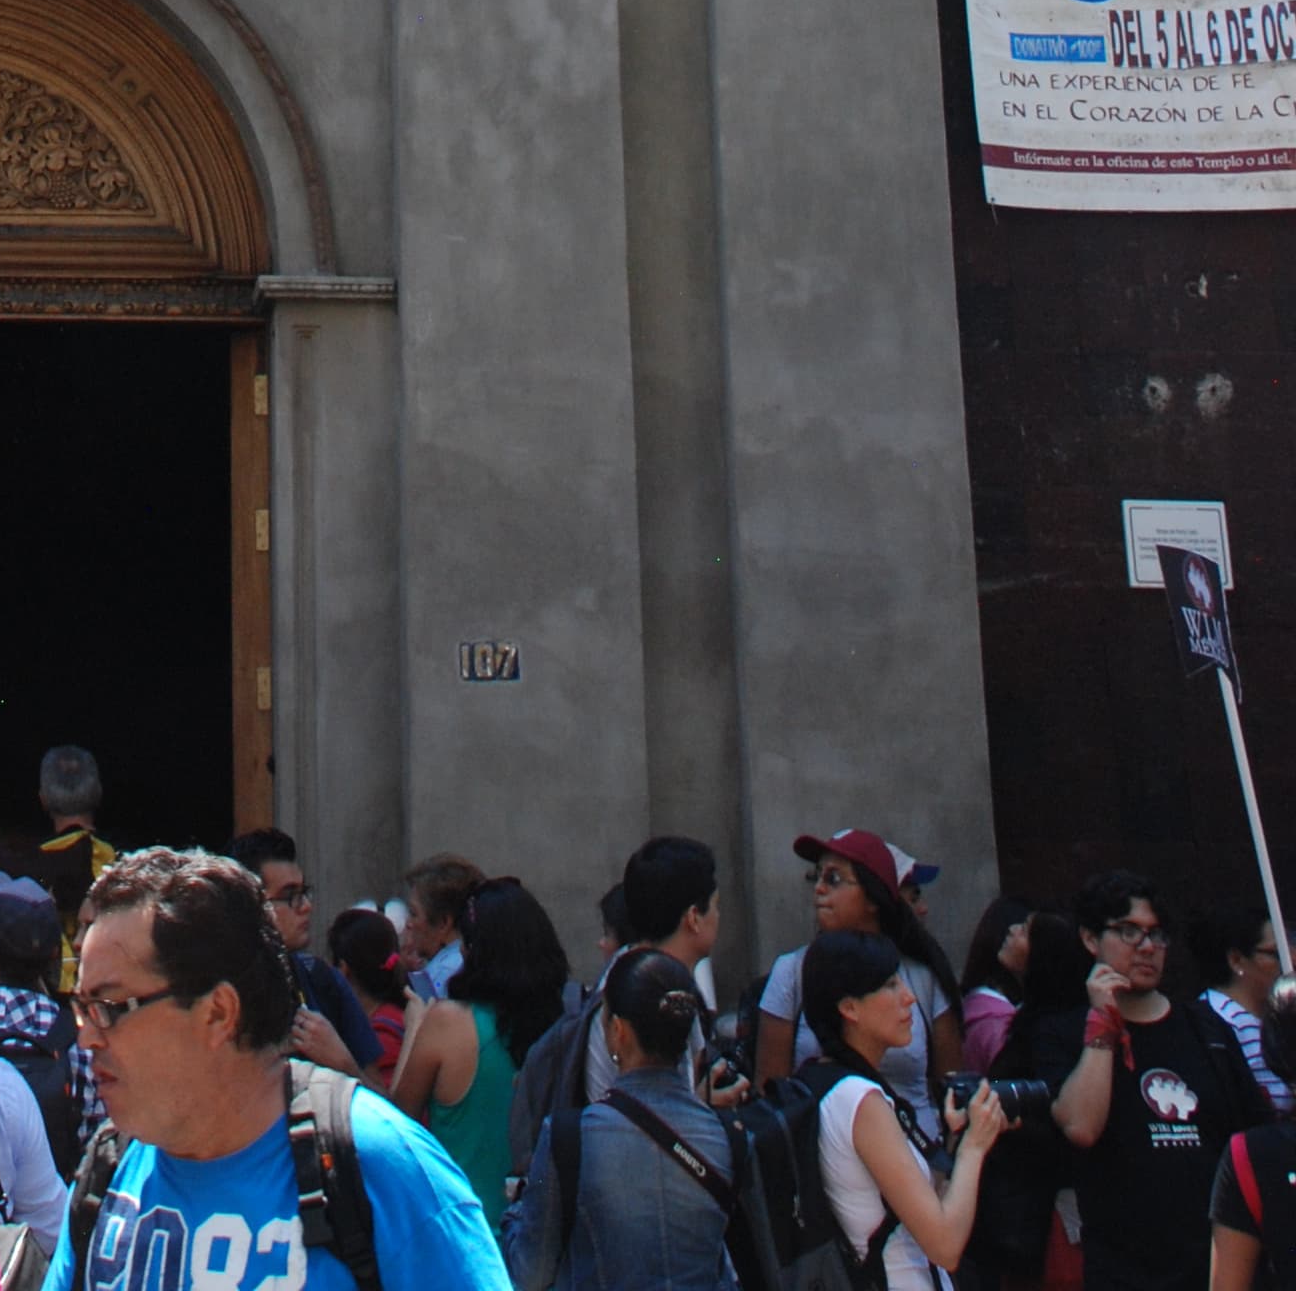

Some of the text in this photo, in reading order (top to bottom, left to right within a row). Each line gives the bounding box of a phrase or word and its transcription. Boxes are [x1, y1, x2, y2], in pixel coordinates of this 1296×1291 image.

[1109, 9, 1152, 68] DEL
[1155, 9, 1169, 68] 5
[1175, 9, 1204, 69] AL
[1207, 10, 1222, 66] 6
[1225, 7, 1258, 64] DE
[1000, 71, 1040, 88] UNA
[1050, 74, 1183, 92] EXPERIENCIA
[1193, 75, 1221, 92] DE
[1003, 95, 1296, 123] EN EL CORAZÓN DE LA C
[1014, 152, 1071, 166] Infórmate
[1074, 157, 1089, 167] en
[1093, 155, 1104, 167] la
[1107, 155, 1148, 169] oficina
[1152, 156, 1167, 169] de
[1170, 158, 1194, 169] este
[1195, 155, 1244, 171] Templo
[1246, 157, 1255, 167] o
[1257, 153, 1269, 166] al
[460, 642, 518, 680] 107
[899, 1109, 928, 1148] Caon
